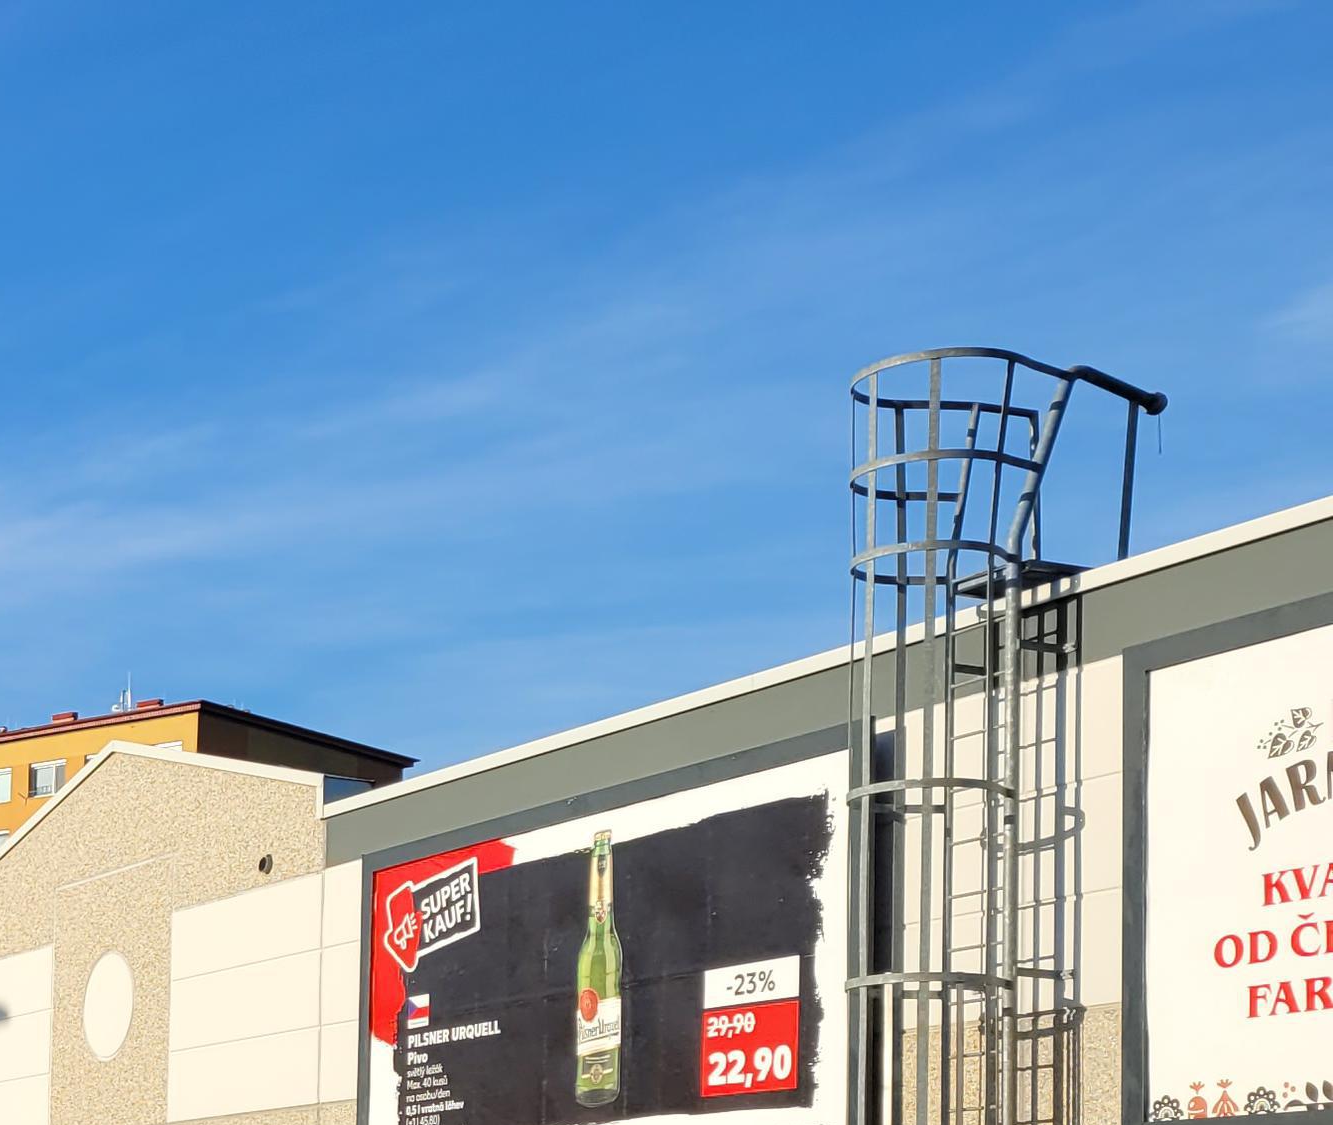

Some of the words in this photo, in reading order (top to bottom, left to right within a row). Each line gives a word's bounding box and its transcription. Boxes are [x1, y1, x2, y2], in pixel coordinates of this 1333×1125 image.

[420, 872, 472, 920] SUPER
[423, 893, 472, 943] KAUF!
[1214, 929, 1278, 968] OD
[726, 969, 776, 996] -23%
[407, 1028, 450, 1050] PILSNER
[451, 1020, 501, 1042] URQUELL
[707, 1011, 756, 1039] 29,90
[407, 1051, 429, 1066] Pivo
[708, 1044, 792, 1089] 22,90
[422, 1077, 432, 1089] 40
[406, 1105, 416, 1117] 0,5
